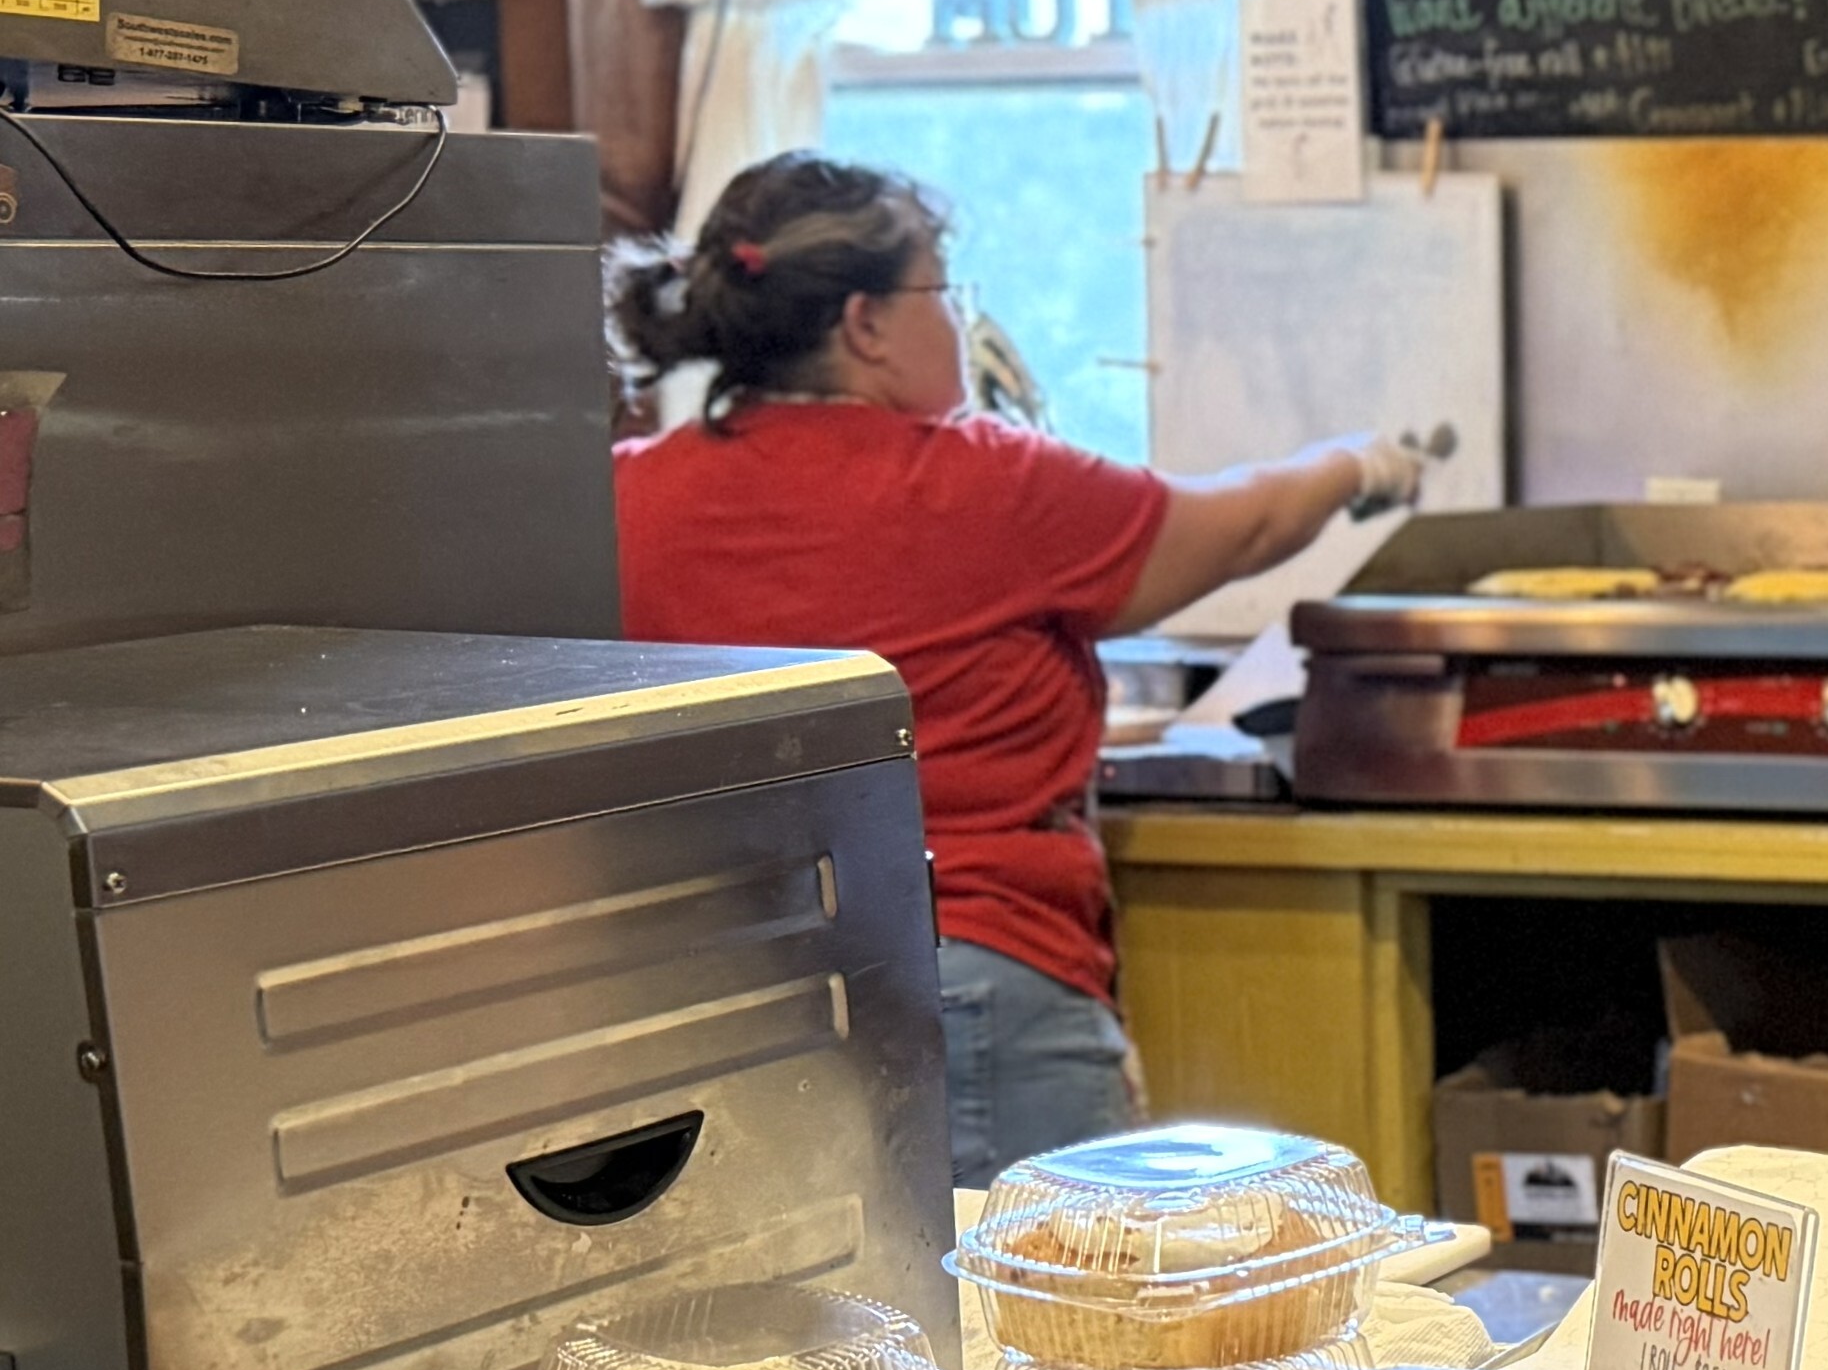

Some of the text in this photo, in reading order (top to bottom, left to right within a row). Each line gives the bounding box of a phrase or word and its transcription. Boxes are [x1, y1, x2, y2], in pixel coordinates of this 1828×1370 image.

[1616, 1179, 1793, 1283] CINNAMON
[1652, 1243, 1752, 1325] ROLLS
[1612, 1289, 1665, 1332] made
[1668, 1306, 1714, 1367] right
